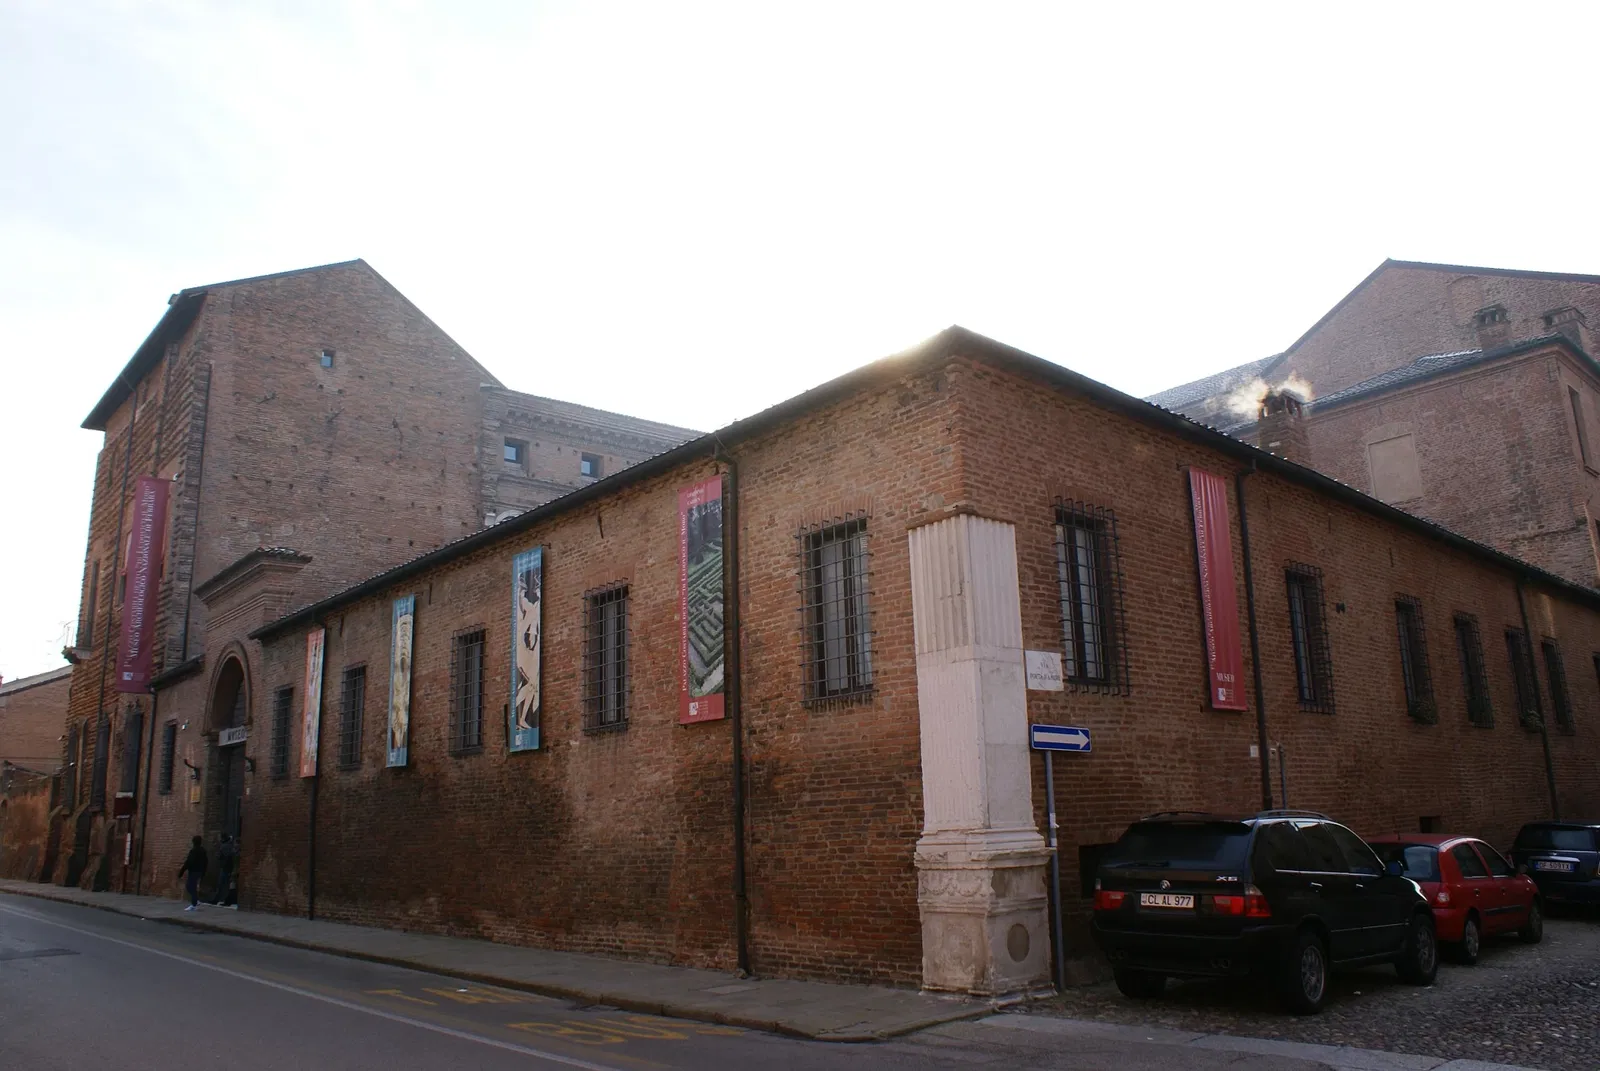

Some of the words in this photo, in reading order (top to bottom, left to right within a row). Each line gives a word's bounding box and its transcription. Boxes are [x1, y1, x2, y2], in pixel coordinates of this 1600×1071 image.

[1215, 671, 1235, 682] MUSEO
[1147, 894, 1160, 905] CL
[1161, 895, 1172, 905] AL
[1174, 895, 1192, 906] 977
